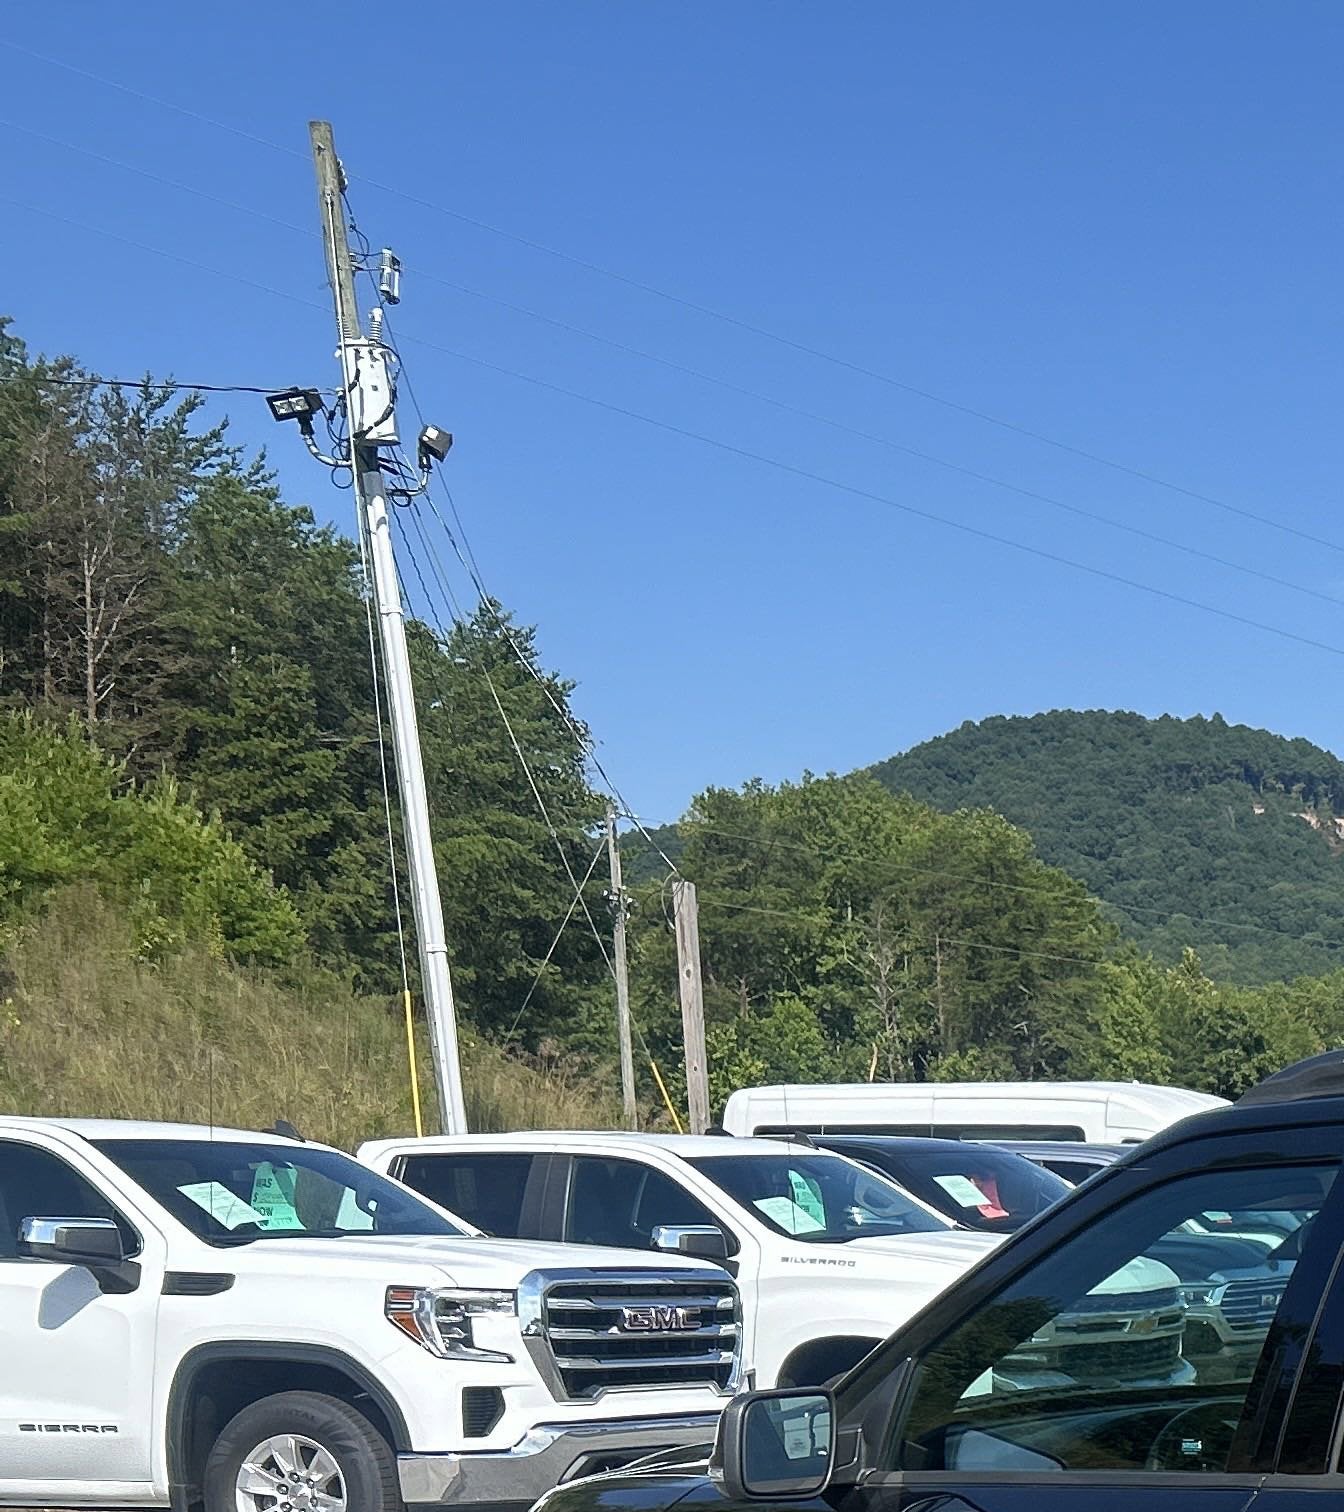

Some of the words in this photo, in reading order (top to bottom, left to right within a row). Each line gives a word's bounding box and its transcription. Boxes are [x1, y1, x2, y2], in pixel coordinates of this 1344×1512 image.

[780, 1256, 856, 1267] SILVERADO
[622, 1306, 702, 1331] GMC
[18, 1423, 119, 1433] SIERRA
